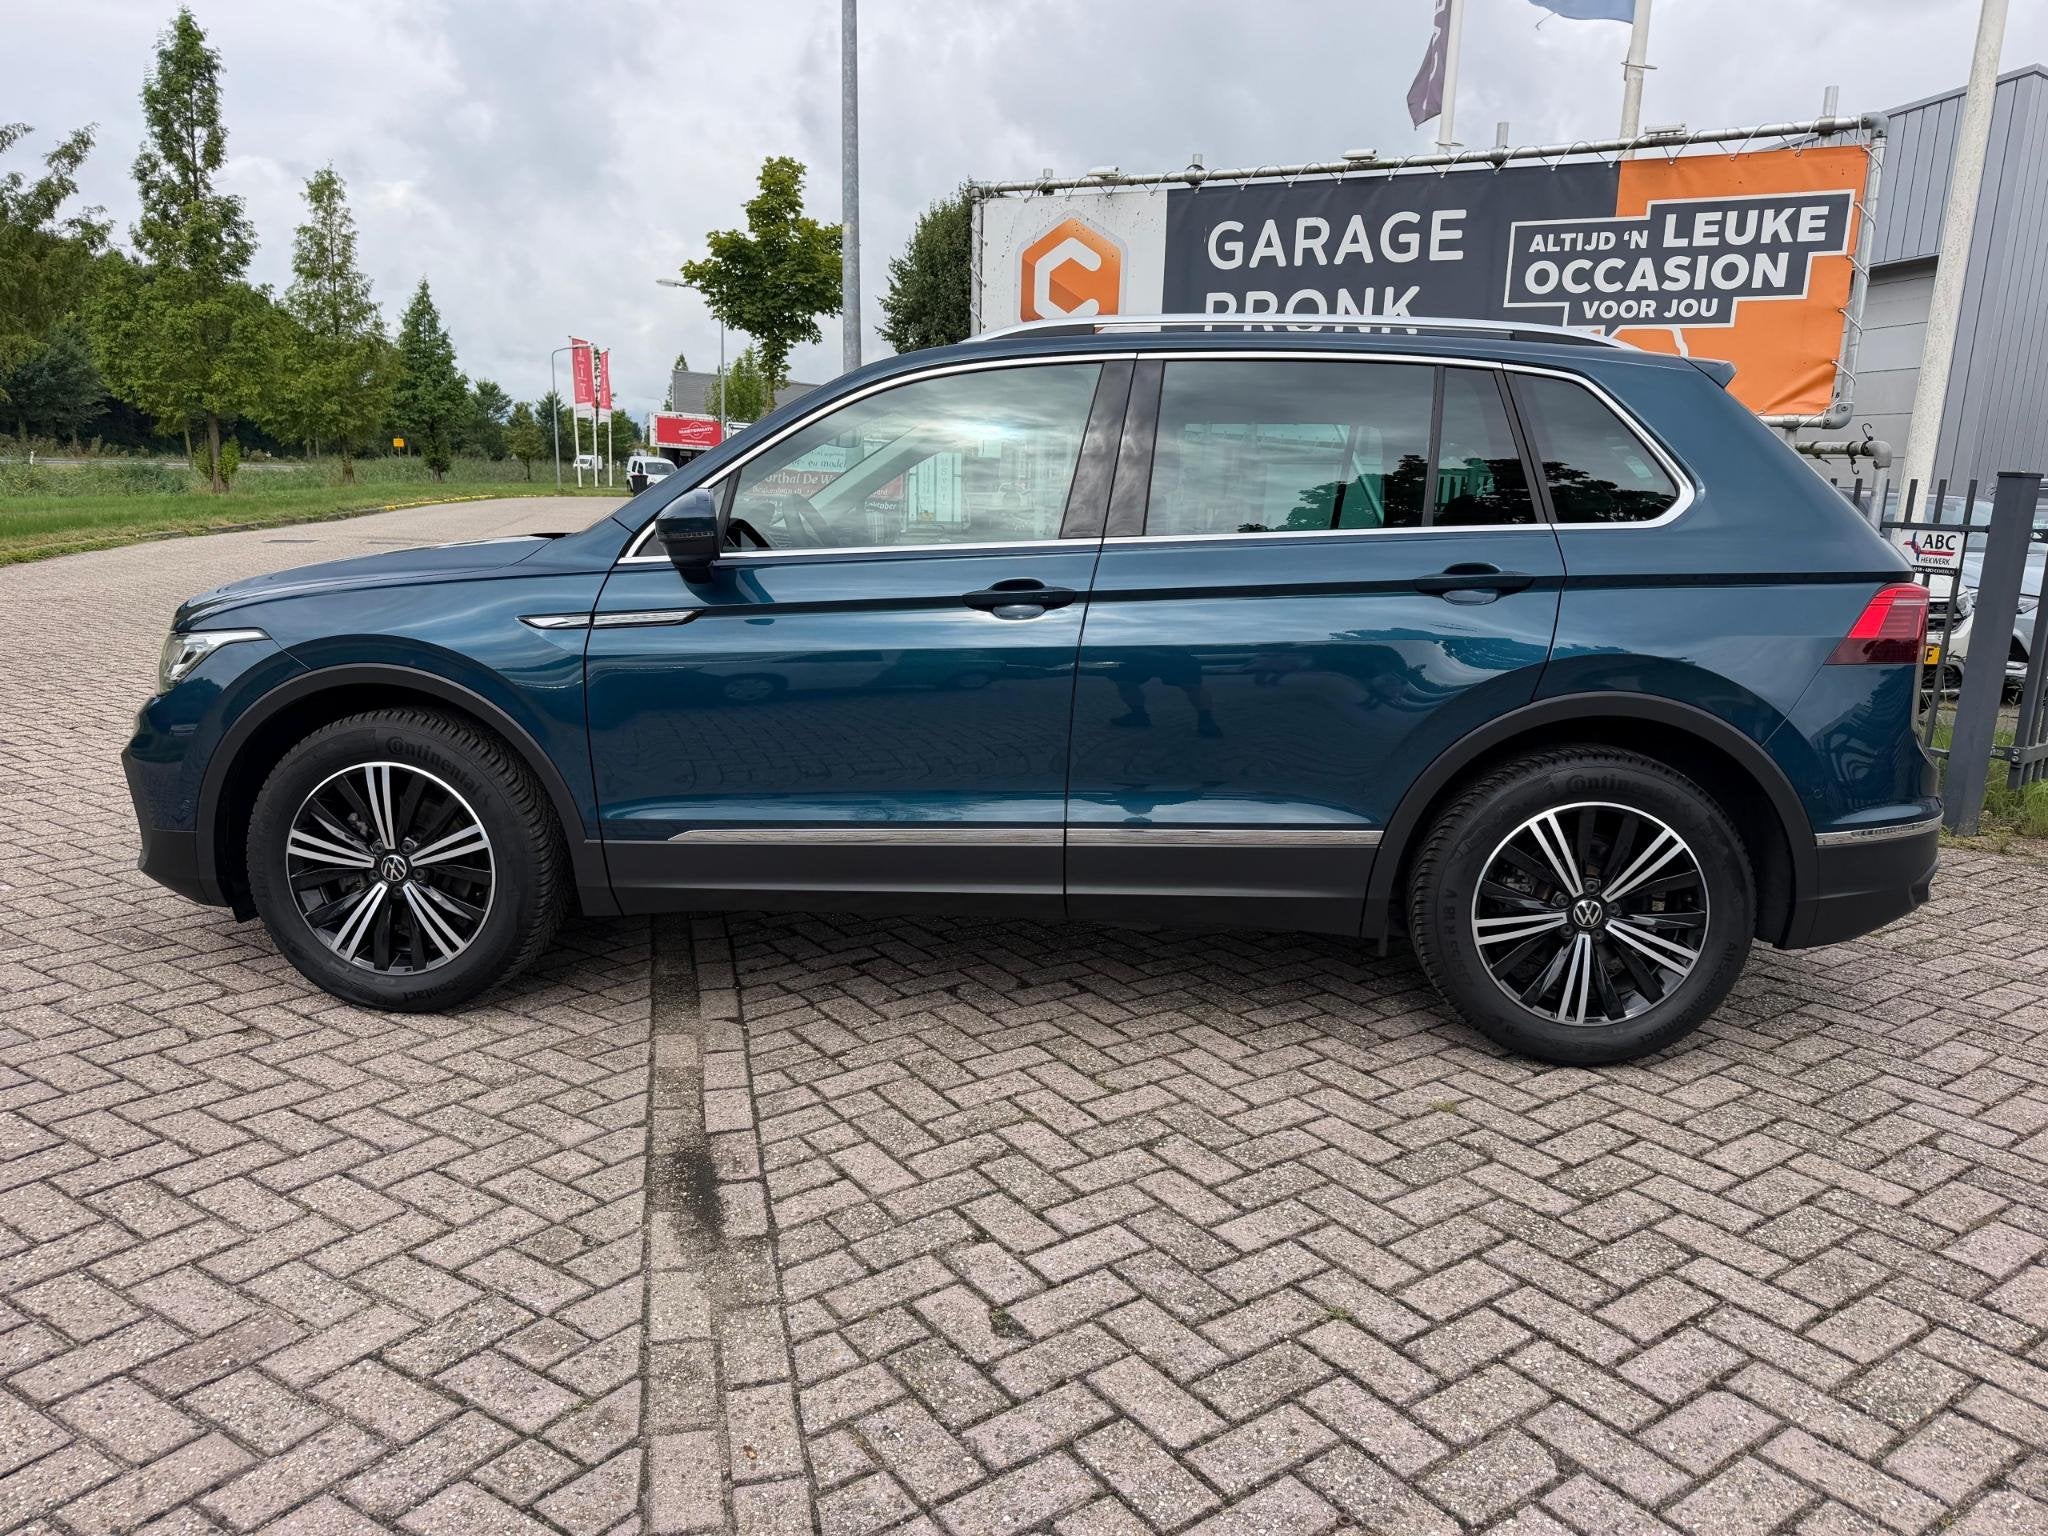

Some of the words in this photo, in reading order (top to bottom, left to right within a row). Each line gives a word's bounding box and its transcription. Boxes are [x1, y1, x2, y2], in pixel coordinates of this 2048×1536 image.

[1207, 209, 1466, 270] GARAGE
[1529, 230, 1616, 253] ALTIJD
[1662, 206, 1829, 249] LEUKE
[1525, 252, 1789, 294] OCCASION
[1204, 286, 1421, 334] PRONK
[1583, 299, 1656, 319] VOOR
[1663, 298, 1718, 318] JOU
[1920, 556, 1951, 567] HEKWERK
[1922, 533, 1957, 551] ABC
